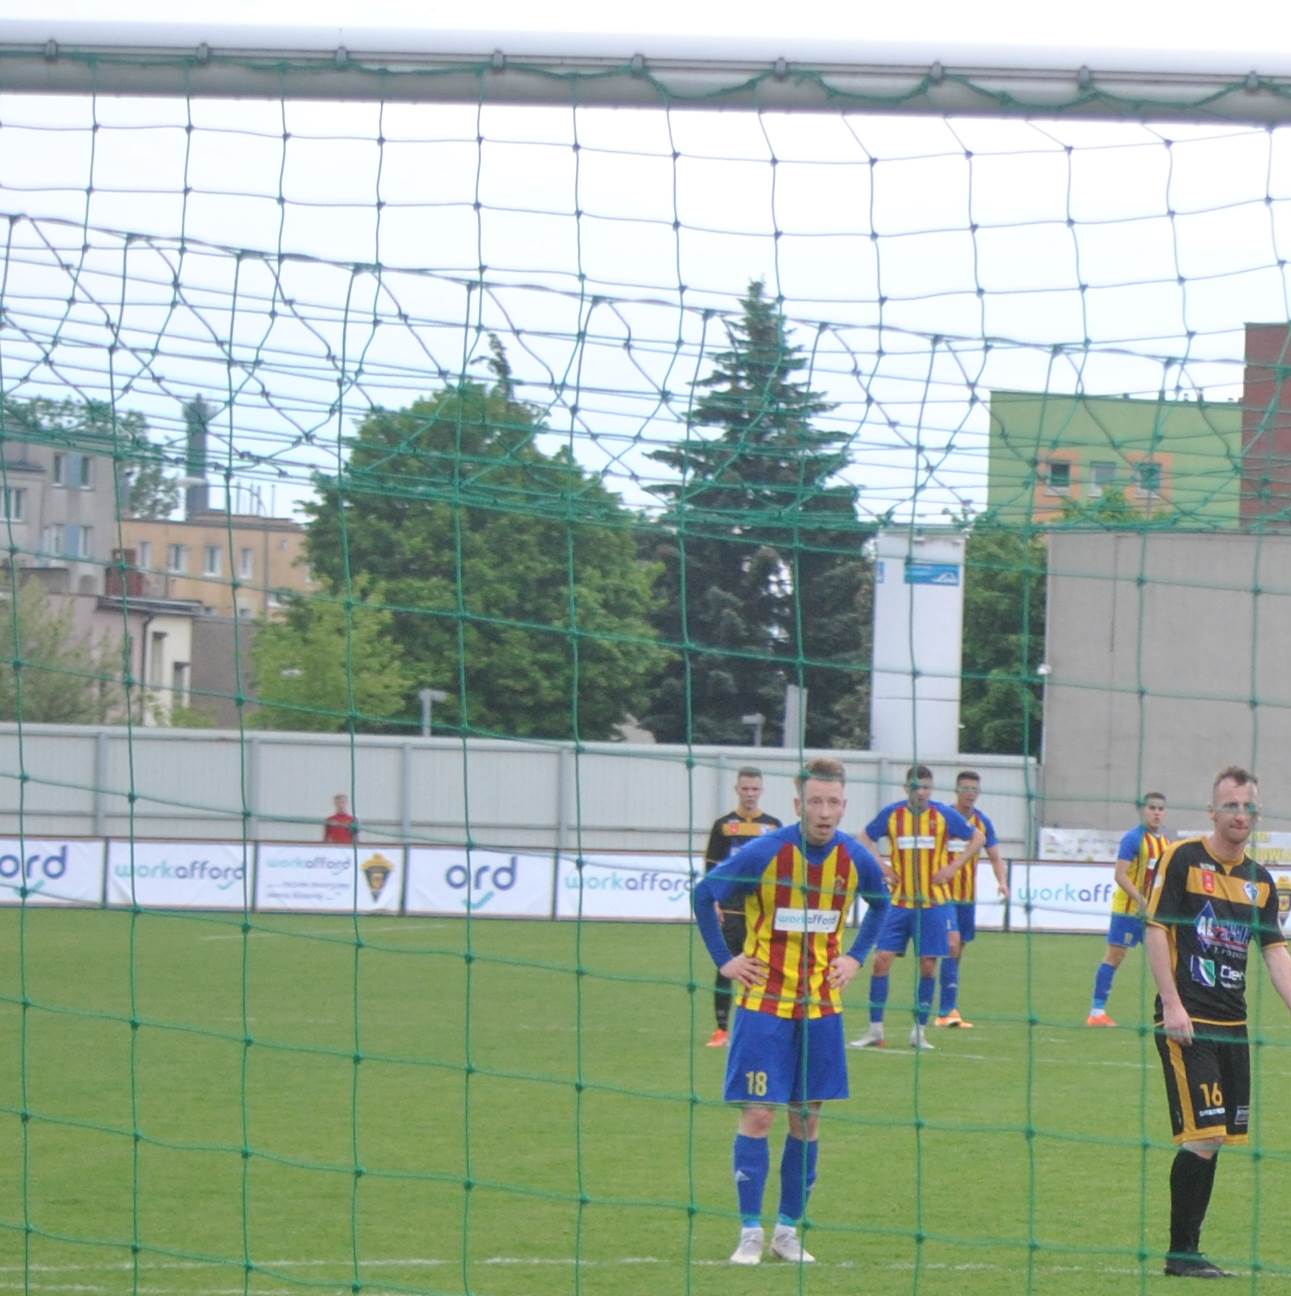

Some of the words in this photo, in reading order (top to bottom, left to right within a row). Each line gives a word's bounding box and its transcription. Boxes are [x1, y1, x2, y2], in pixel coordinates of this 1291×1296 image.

[0, 845, 67, 880] ord
[445, 856, 517, 892] ord
[745, 1071, 768, 1096] 18
[1200, 1082, 1223, 1108] 16
